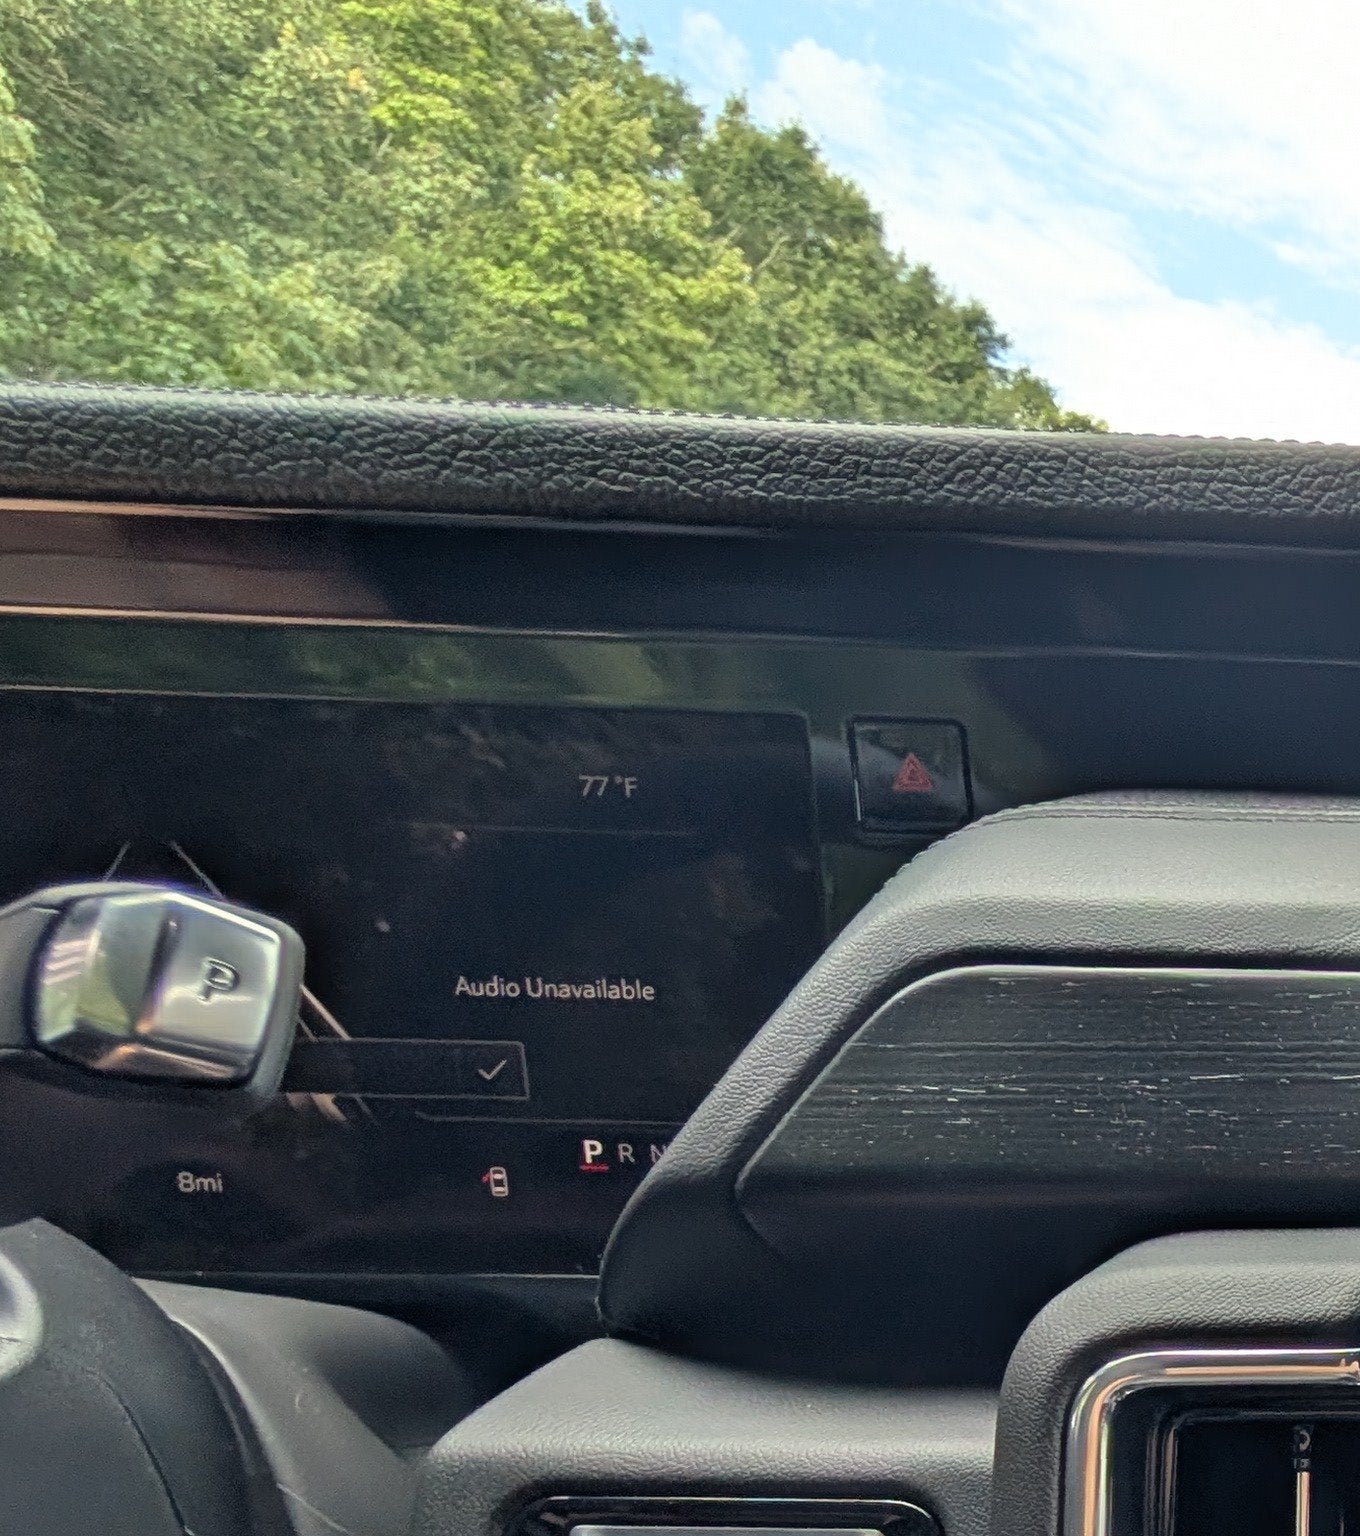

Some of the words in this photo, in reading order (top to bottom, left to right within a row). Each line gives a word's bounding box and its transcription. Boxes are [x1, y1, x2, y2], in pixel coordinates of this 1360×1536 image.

[455, 975, 521, 997] Audio
[525, 977, 655, 1001] Unavailable
[582, 1138, 604, 1164] P
[617, 1142, 636, 1163] R
[176, 1170, 224, 1194] 8mi
